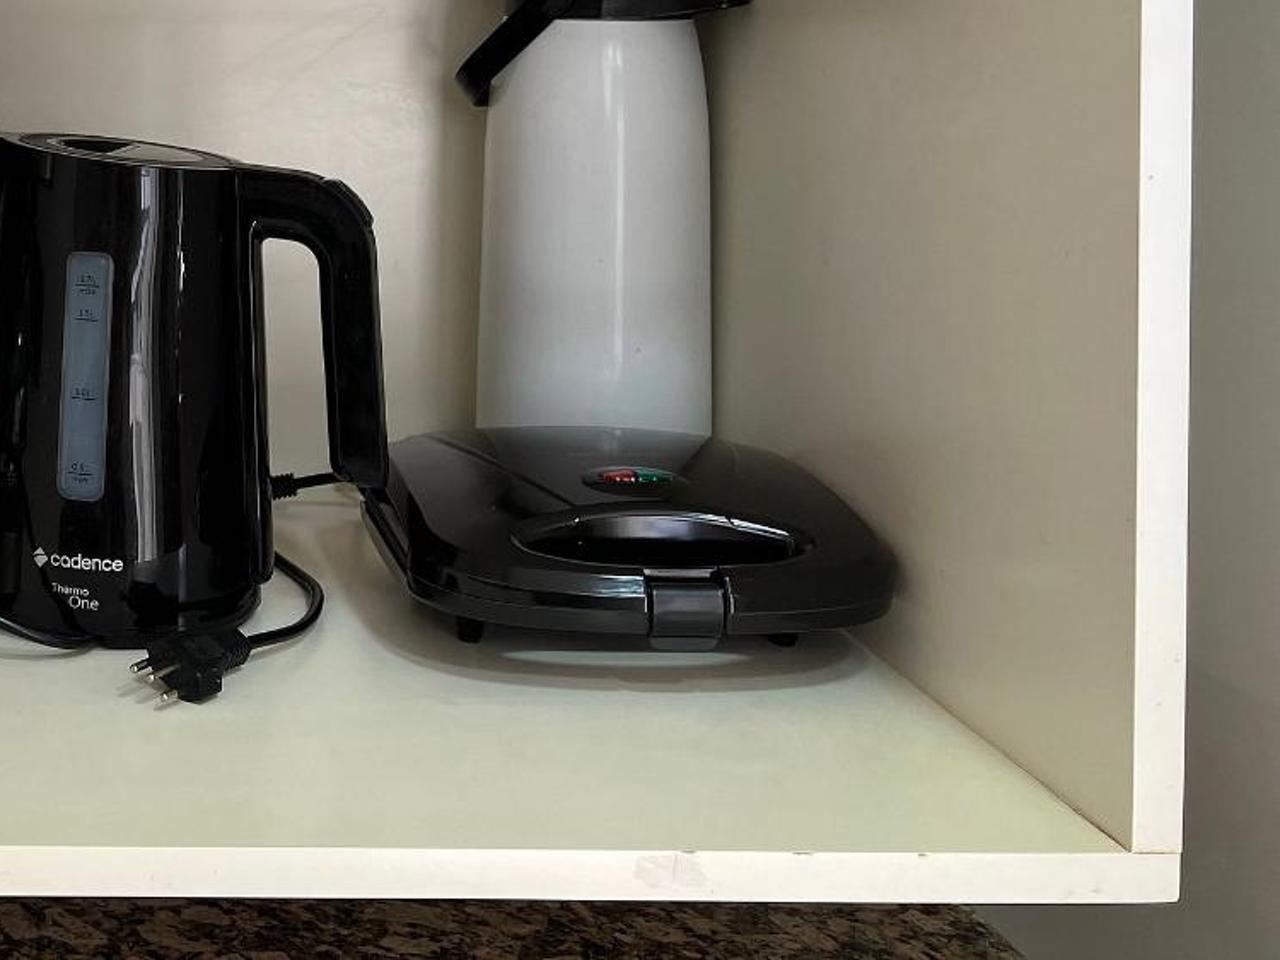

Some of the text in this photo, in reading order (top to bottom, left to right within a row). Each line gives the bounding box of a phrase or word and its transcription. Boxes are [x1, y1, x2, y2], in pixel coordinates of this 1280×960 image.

[49, 553, 124, 573] cadence
[51, 582, 90, 597] Thermo
[68, 595, 100, 611] One
